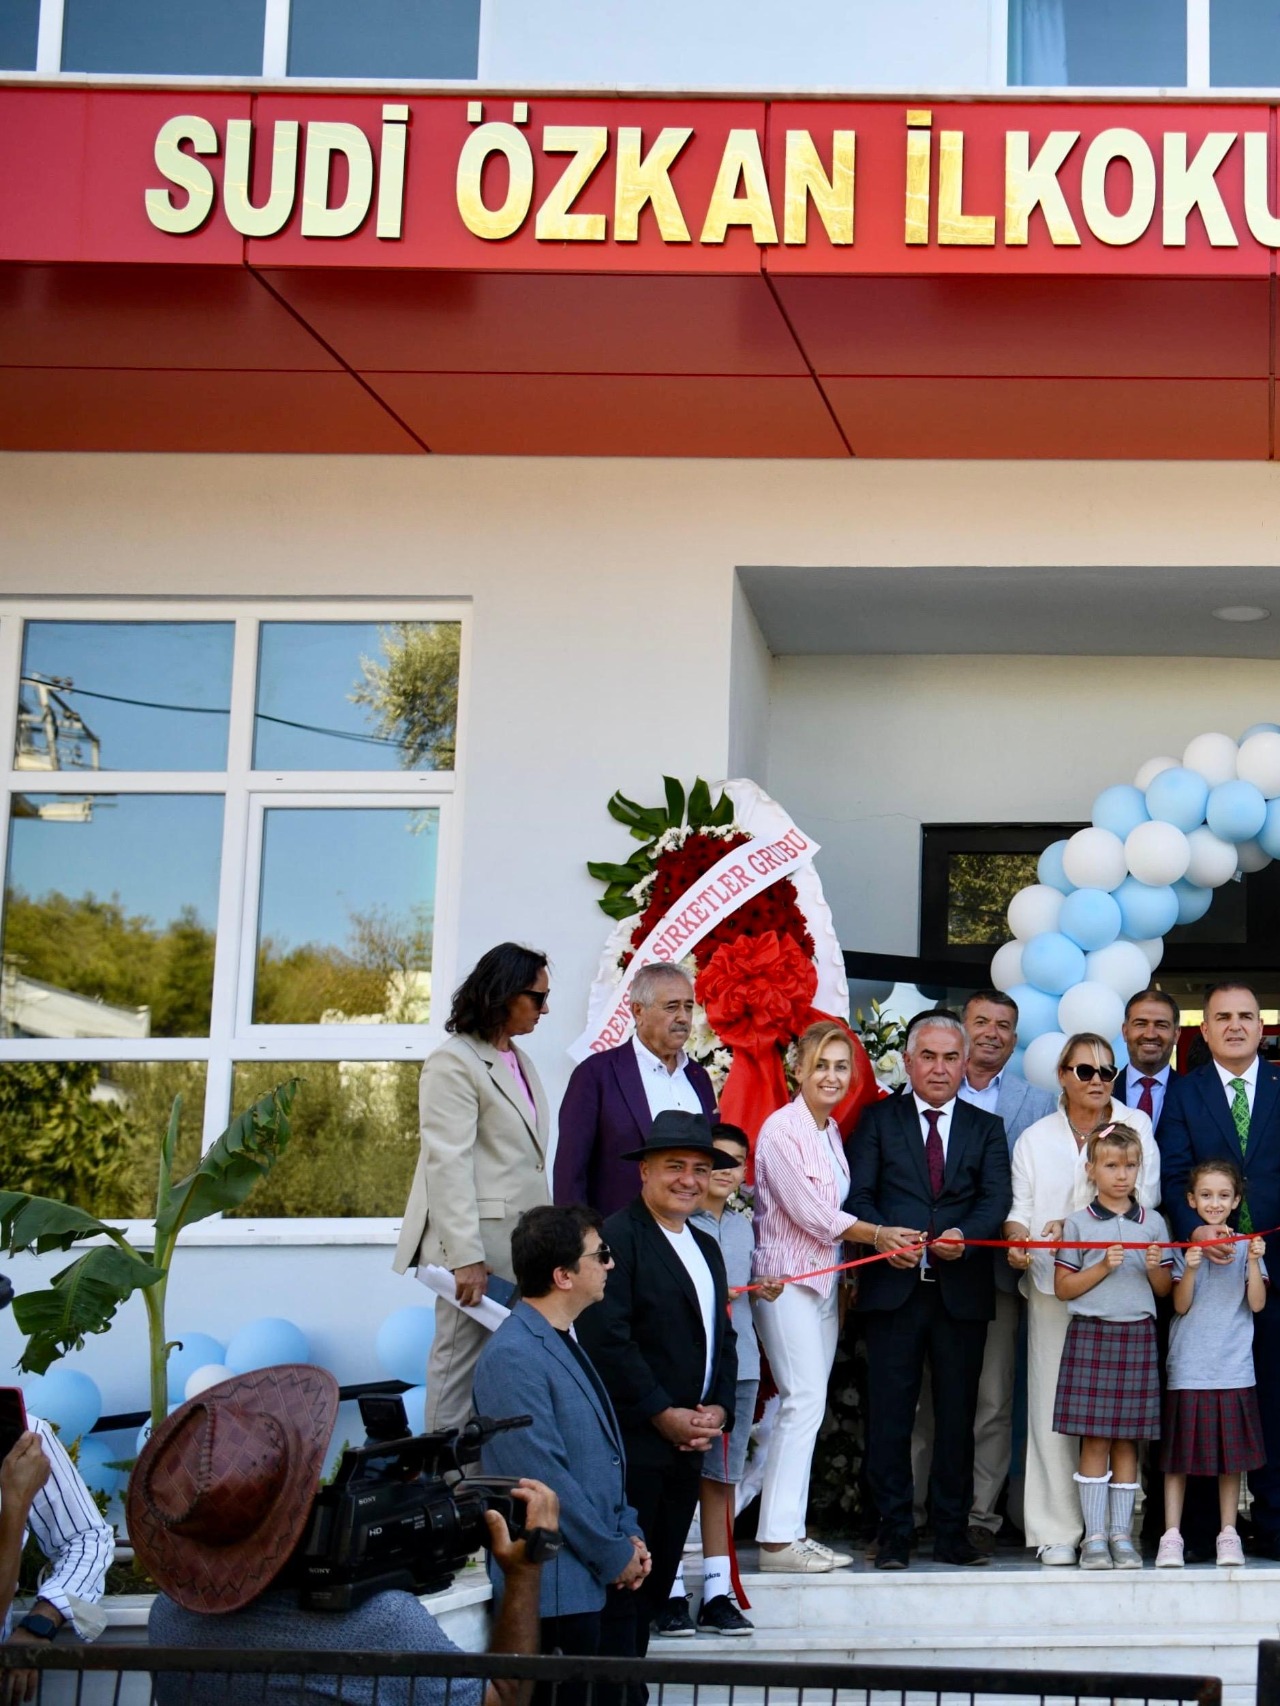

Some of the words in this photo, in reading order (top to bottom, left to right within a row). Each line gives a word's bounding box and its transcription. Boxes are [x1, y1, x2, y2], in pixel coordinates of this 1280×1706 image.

[145, 104, 408, 238] SUDİ
[456, 102, 856, 245] ÖZKAN
[358, 1495, 376, 1505] SONY
[369, 1526, 383, 1537] HD
[308, 1567, 330, 1575] SONY
